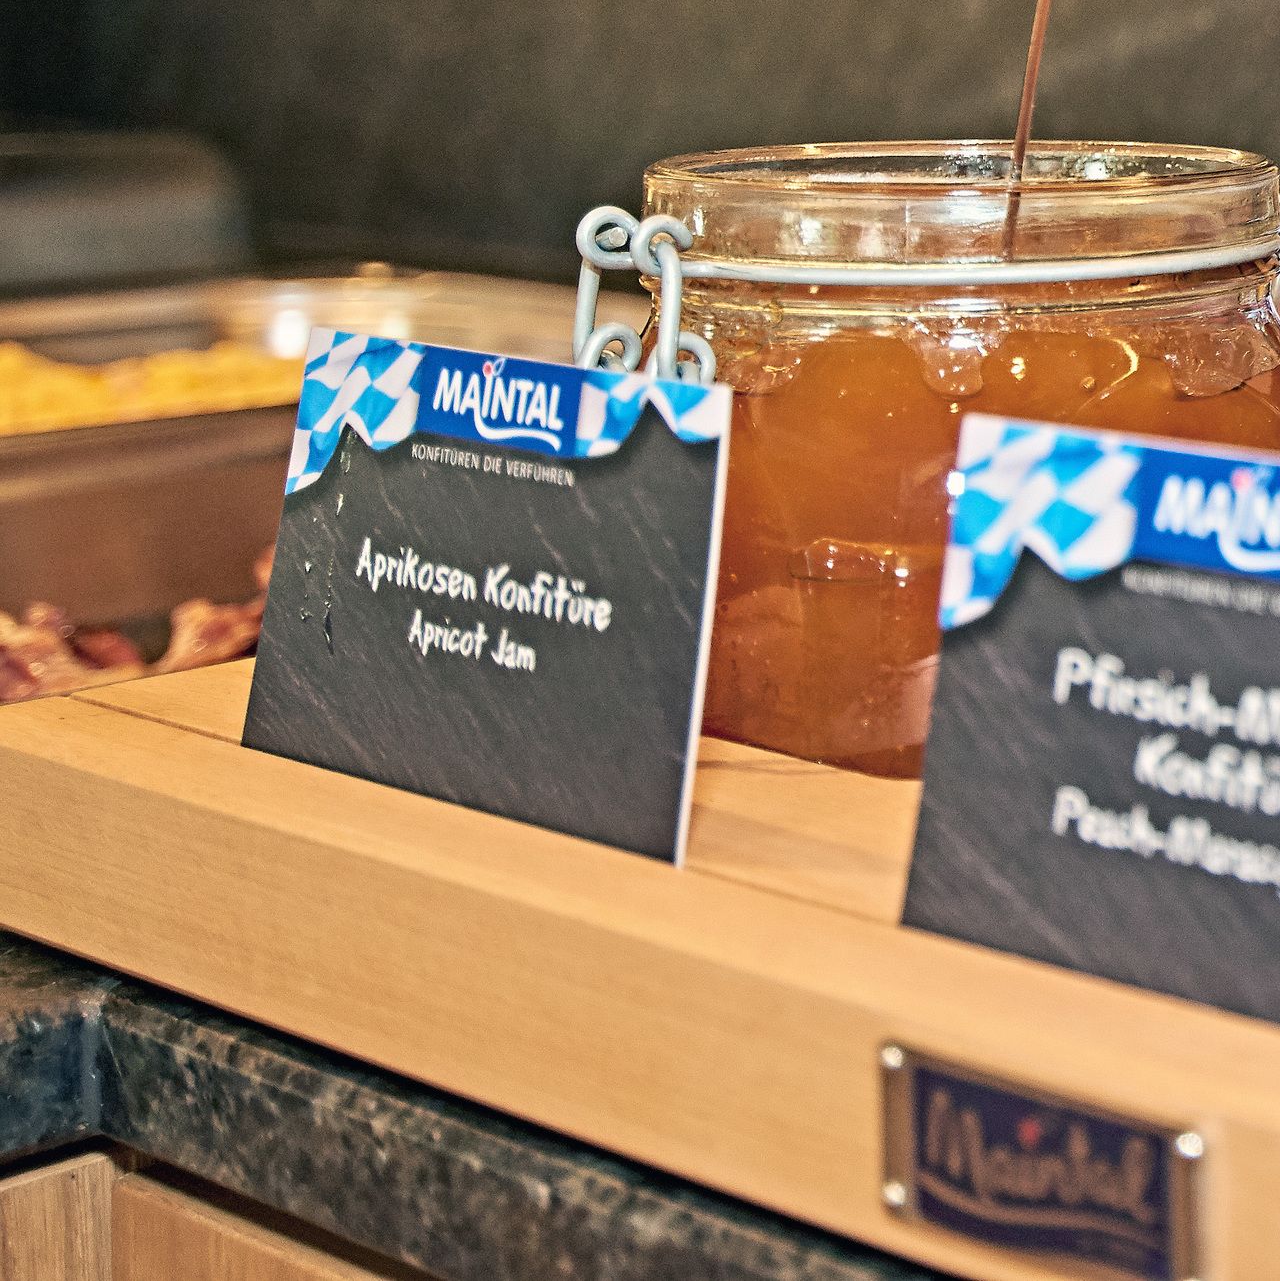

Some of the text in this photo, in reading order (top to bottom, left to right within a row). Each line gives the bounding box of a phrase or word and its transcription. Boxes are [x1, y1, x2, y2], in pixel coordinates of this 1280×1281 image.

[432, 361, 565, 449] MAINTAL
[483, 455, 503, 475] DIE
[484, 563, 613, 633] Konfitüre
[408, 608, 538, 674] Apricot Jam
